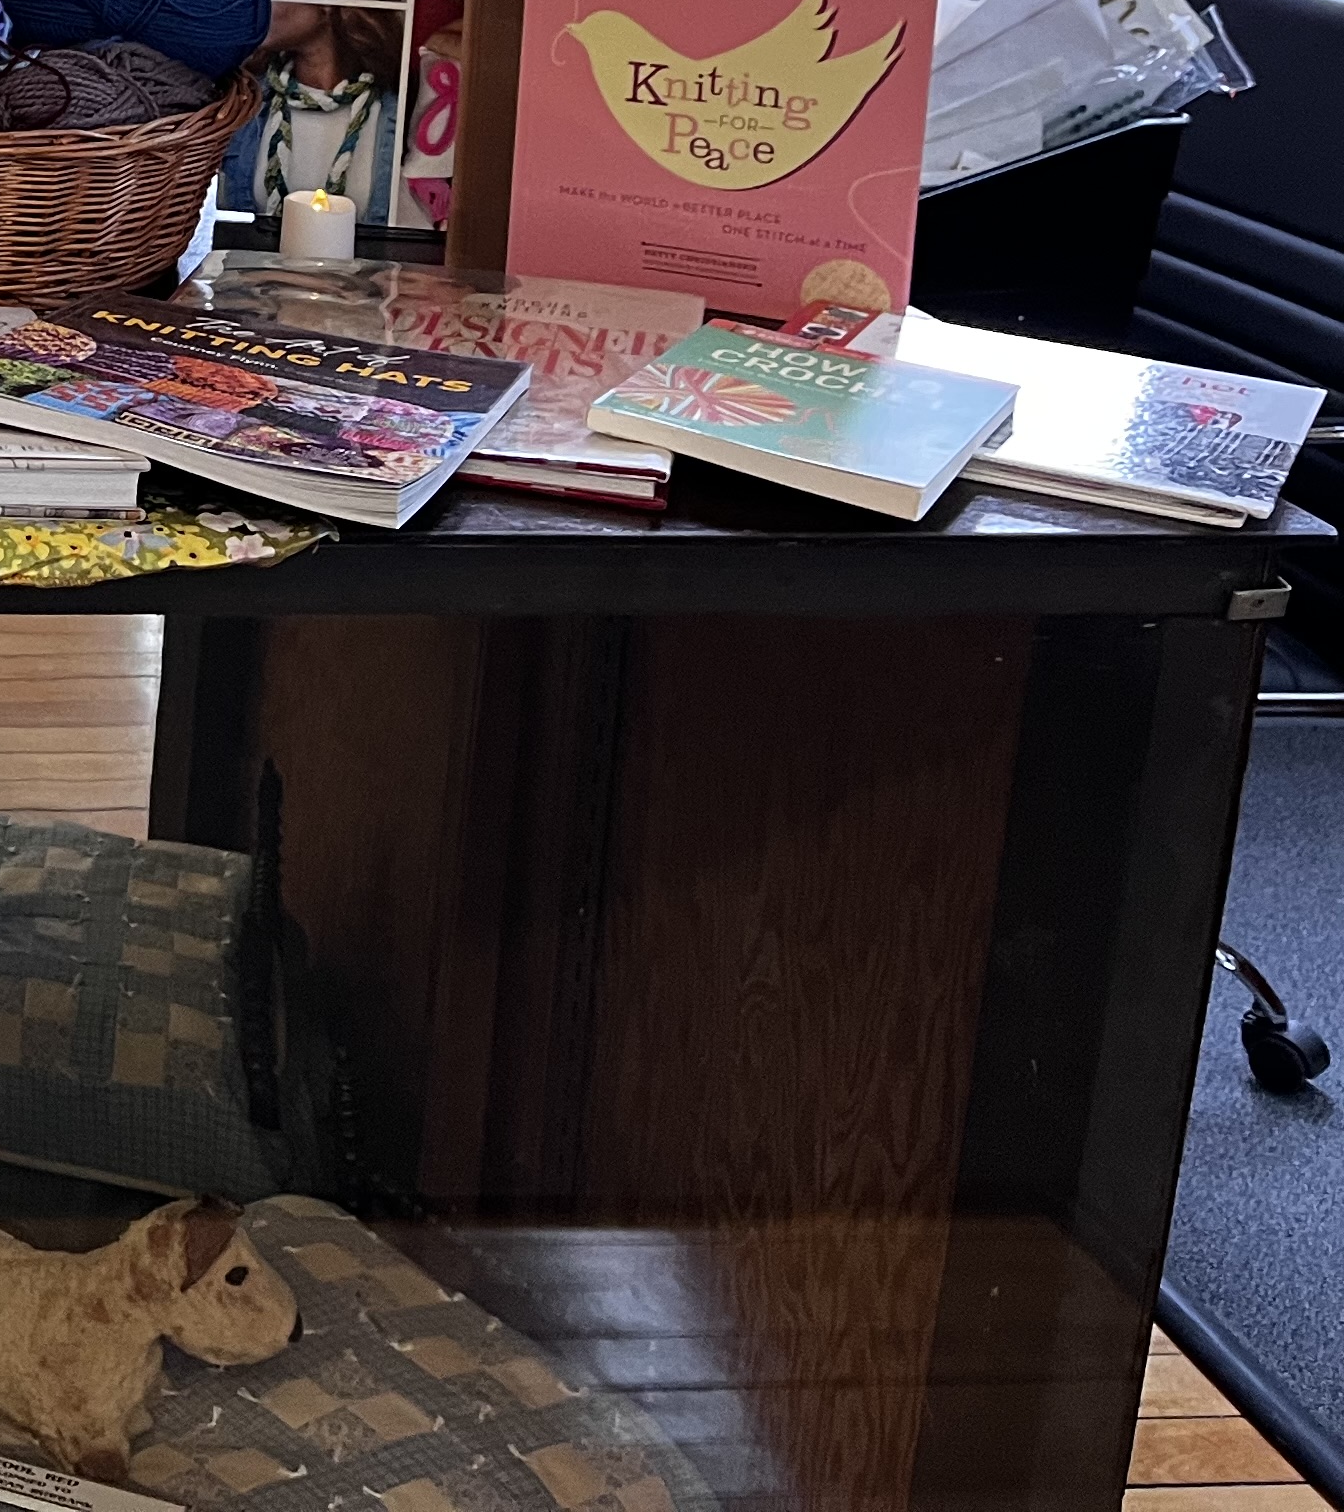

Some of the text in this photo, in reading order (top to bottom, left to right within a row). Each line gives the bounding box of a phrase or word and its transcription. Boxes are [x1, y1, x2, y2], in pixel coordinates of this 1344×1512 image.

[625, 61, 818, 130] Knitting
[661, 112, 776, 171] Peace
[559, 186, 595, 199] MAKE
[598, 192, 616, 202] the
[620, 193, 669, 209] WORLD
[683, 201, 733, 218] BETTER
[737, 210, 782, 224] PLACE
[390, 307, 672, 356] DESIGNER
[480, 303, 588, 318] KNITTING
[91, 310, 323, 366] KNITTING
[335, 362, 474, 392] HATS
[747, 342, 867, 377] HOW
